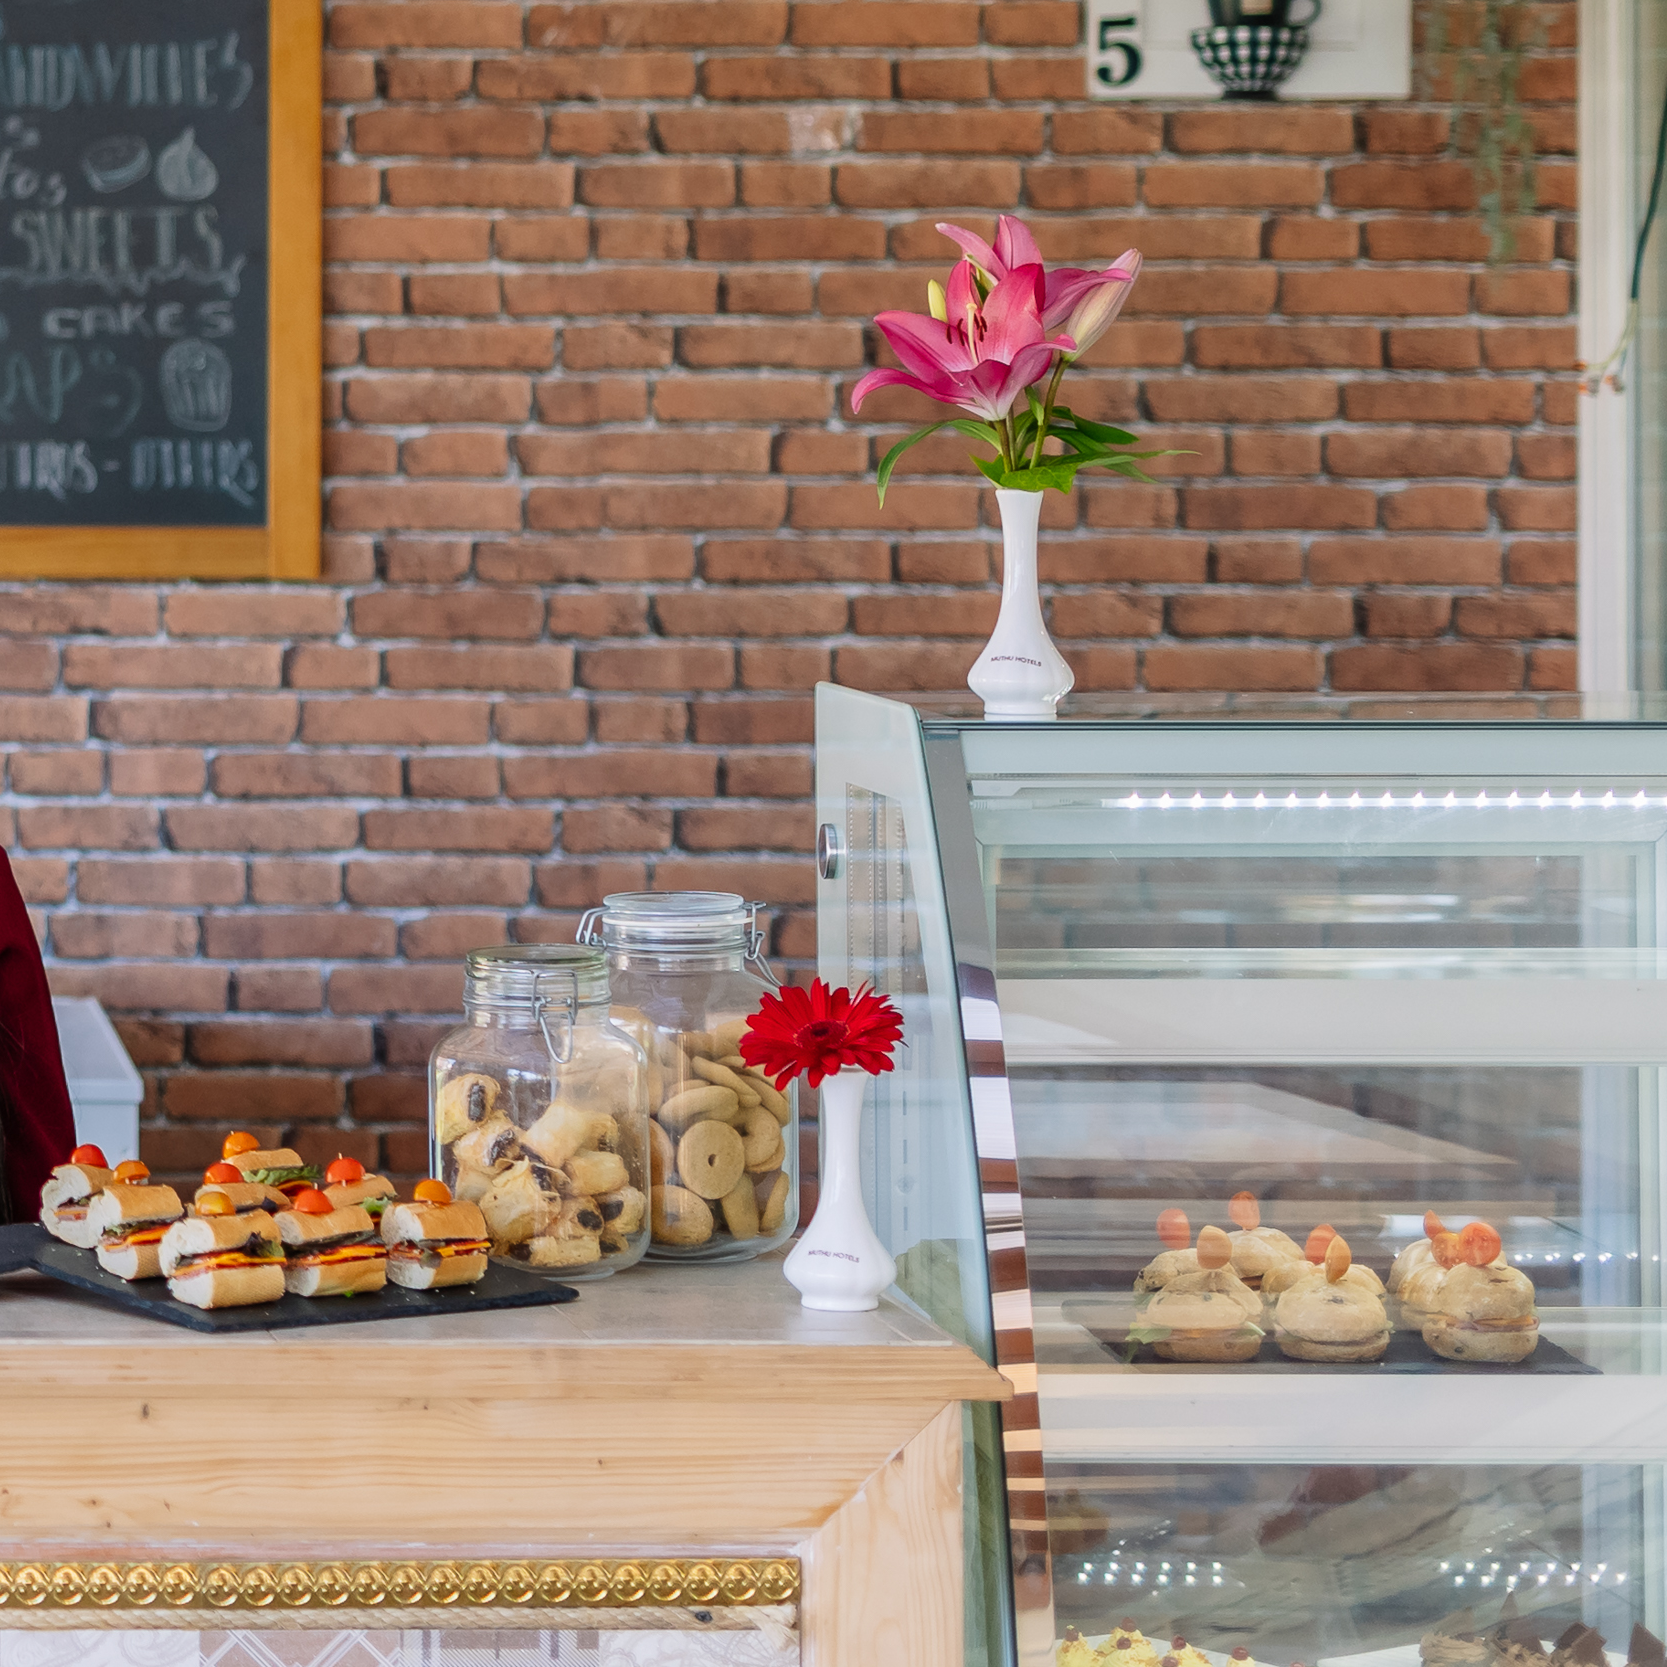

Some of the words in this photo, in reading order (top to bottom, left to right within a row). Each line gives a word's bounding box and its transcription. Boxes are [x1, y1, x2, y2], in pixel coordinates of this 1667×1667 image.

[1097, 16, 1143, 87] 5
[43, 300, 236, 339] CAKES
[1015, 656, 1042, 667] HOTELS
